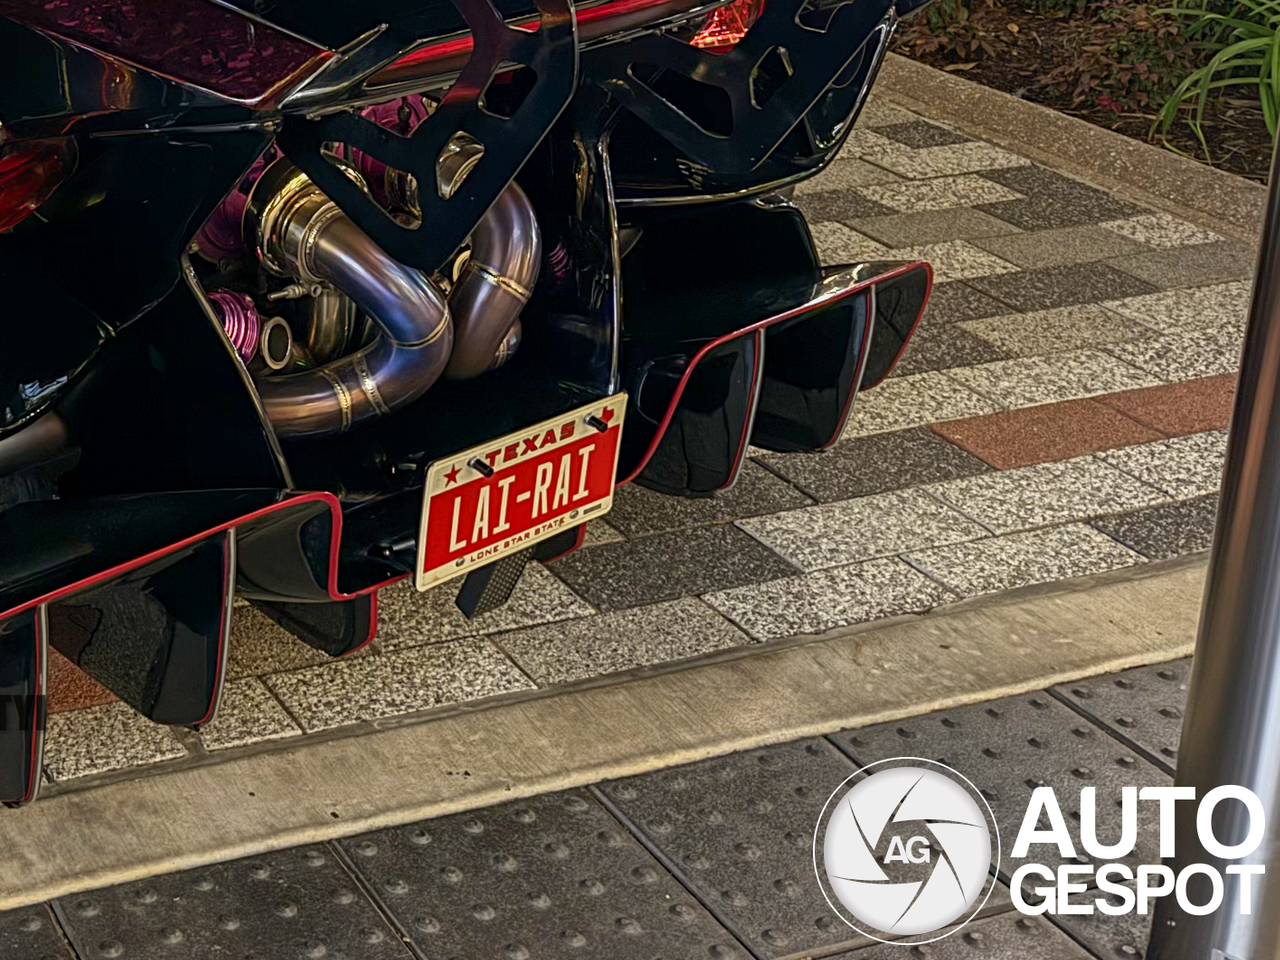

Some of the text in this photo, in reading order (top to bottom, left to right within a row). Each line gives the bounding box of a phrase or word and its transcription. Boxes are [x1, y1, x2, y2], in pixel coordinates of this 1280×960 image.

[485, 420, 576, 468] TEXAS
[449, 443, 596, 553] LAI-RAI
[470, 517, 566, 563] LONE STAR STATE
